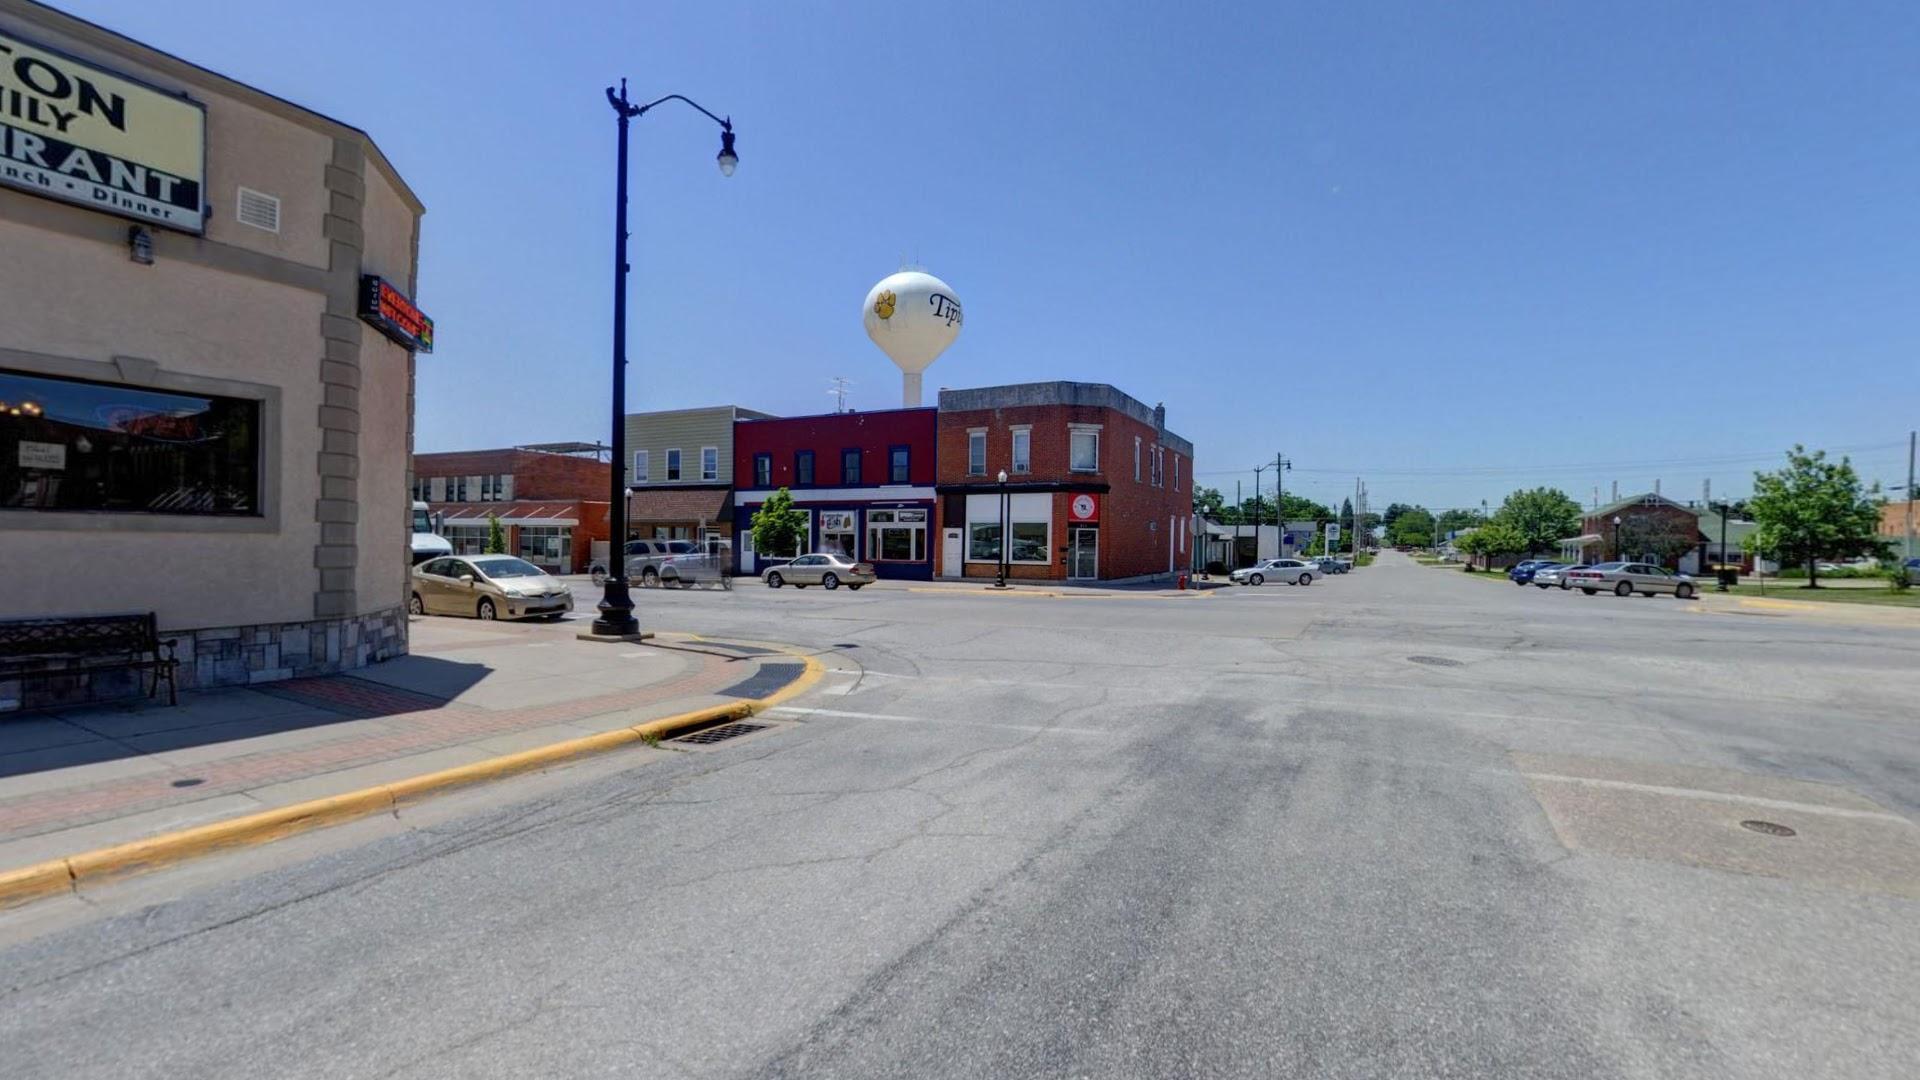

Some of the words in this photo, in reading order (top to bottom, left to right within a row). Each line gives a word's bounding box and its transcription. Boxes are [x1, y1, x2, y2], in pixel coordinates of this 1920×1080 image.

[0, 86, 77, 132] ILY
[0, 165, 51, 187] nch
[93, 187, 173, 219] Dinner
